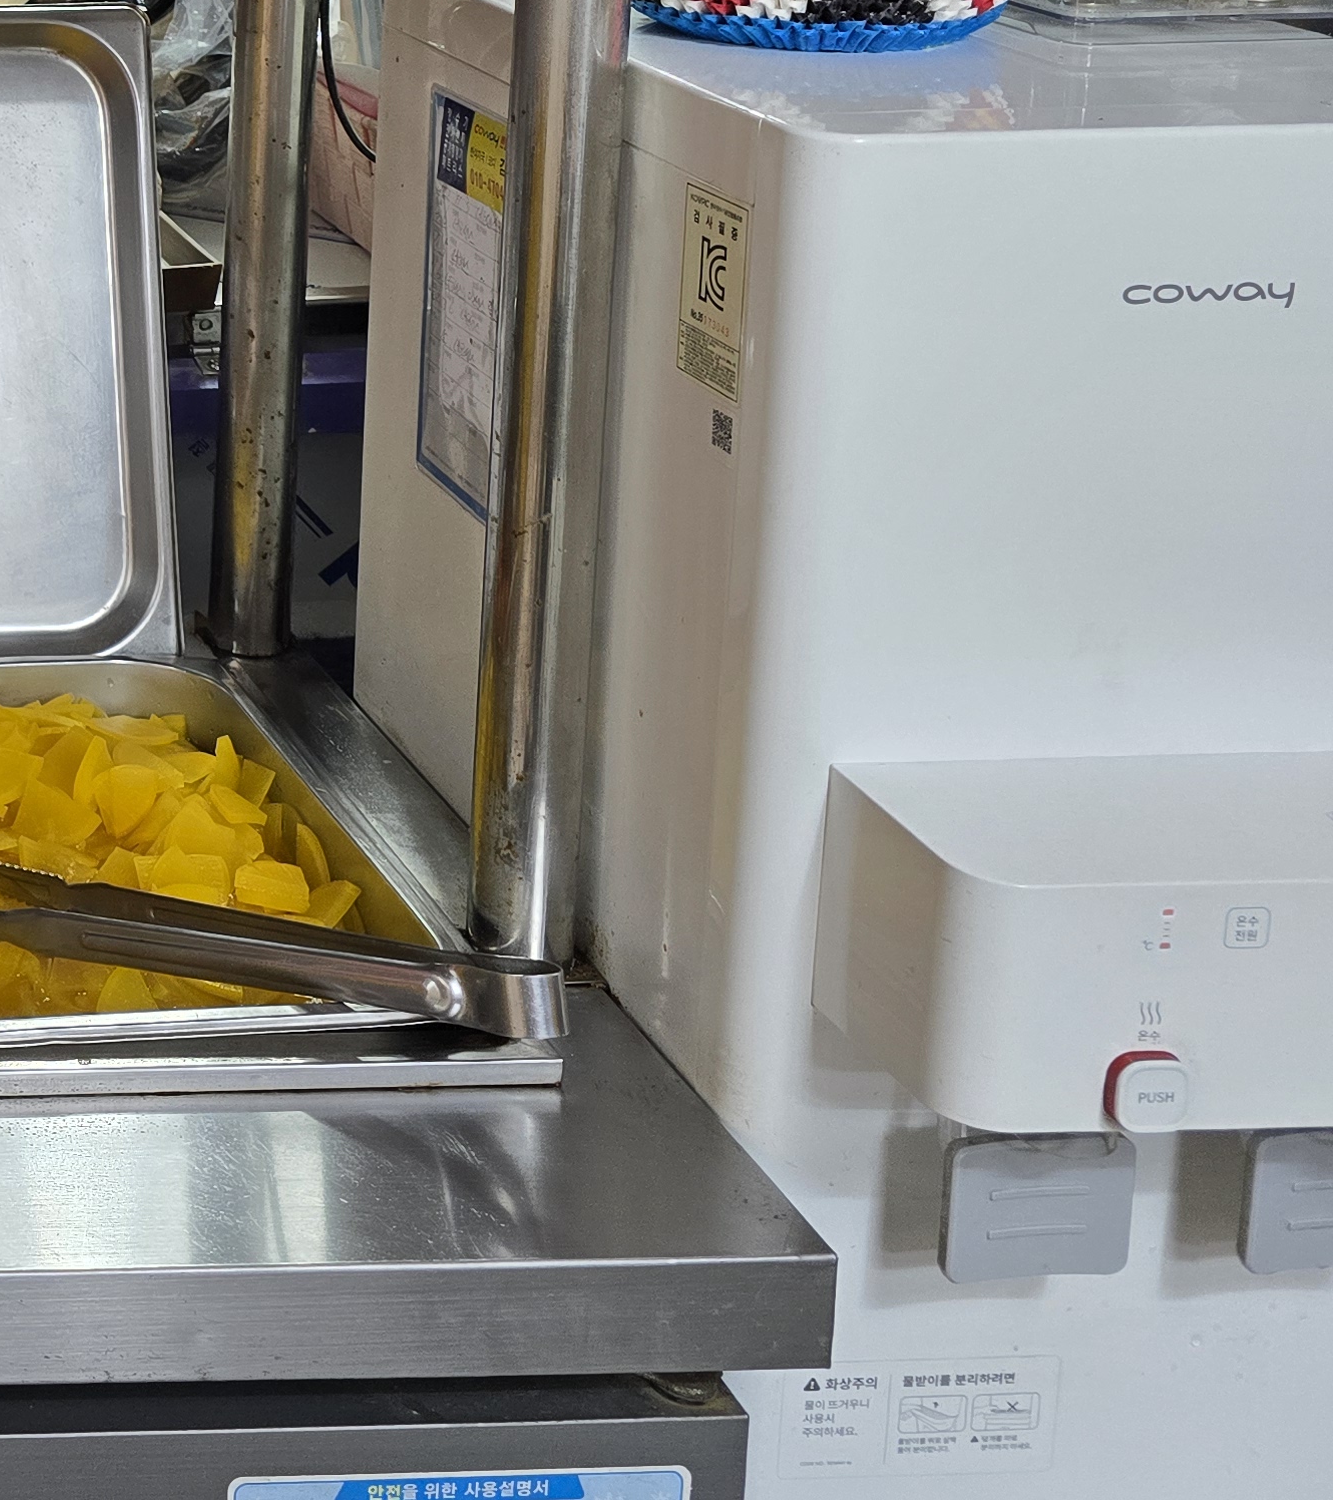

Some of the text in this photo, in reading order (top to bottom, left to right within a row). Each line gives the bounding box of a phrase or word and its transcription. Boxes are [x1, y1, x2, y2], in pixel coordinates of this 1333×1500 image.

[1122, 281, 1296, 309] coway
[1235, 914, 1259, 928] 온수
[1137, 1029, 1161, 1042] 온수
[1137, 1091, 1175, 1104] PUSH
[824, 1376, 878, 1391] 화상주의
[902, 1372, 1016, 1387] 물받이를 분리하려면
[804, 1398, 870, 1411] 물이 뜨거우니
[802, 1426, 858, 1438] 주의하세요.
[367, 1479, 550, 1500] 안전을 위한 사용설명서
